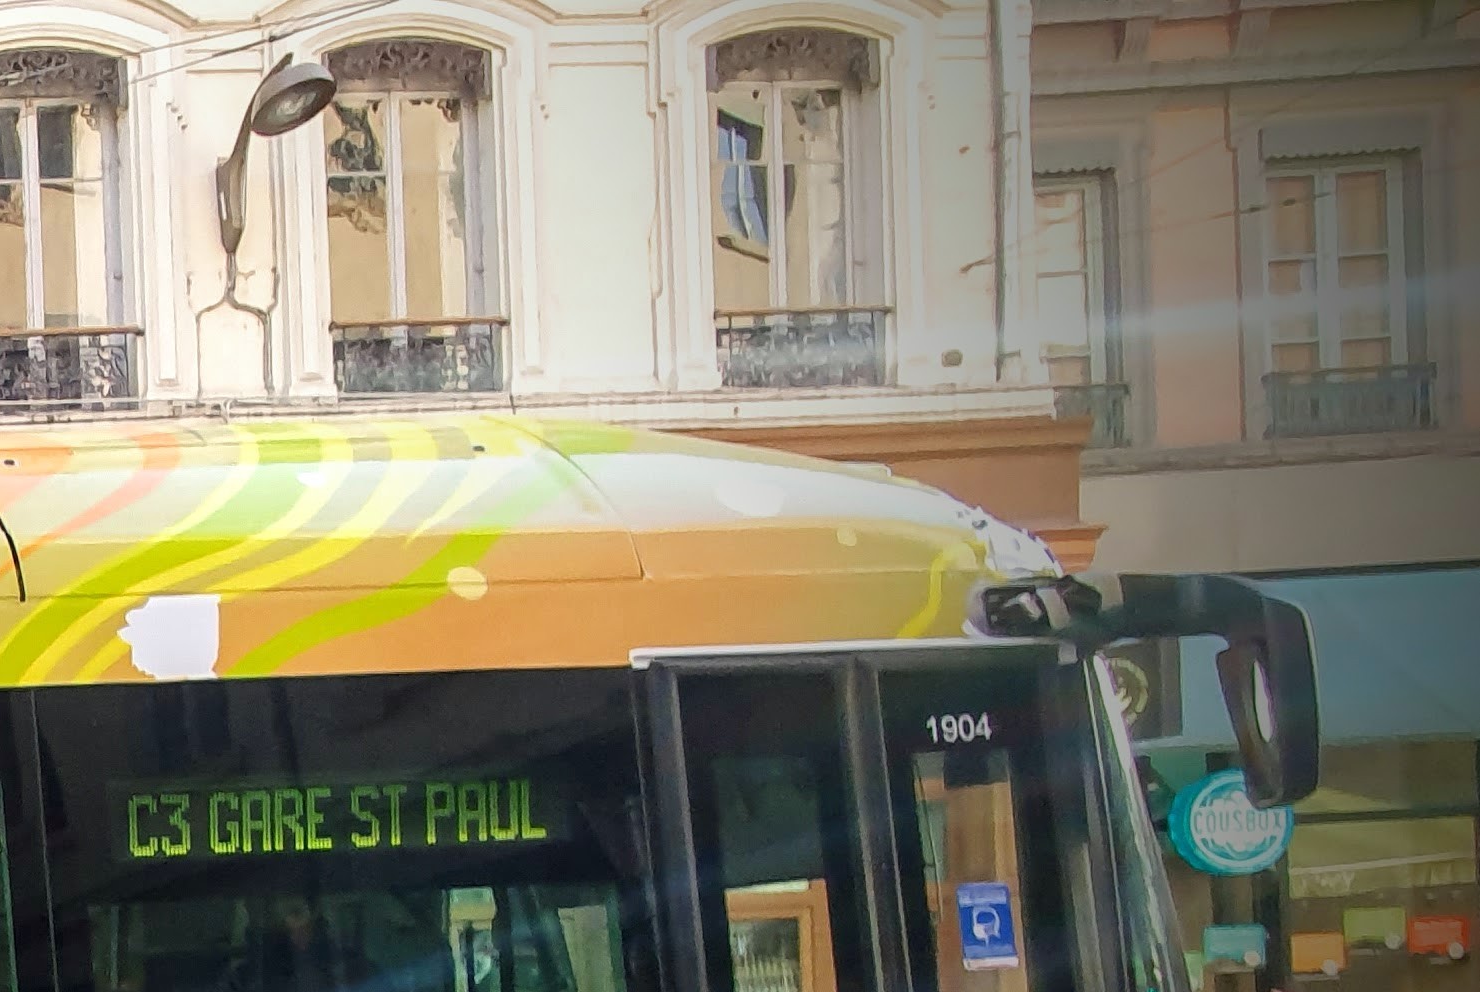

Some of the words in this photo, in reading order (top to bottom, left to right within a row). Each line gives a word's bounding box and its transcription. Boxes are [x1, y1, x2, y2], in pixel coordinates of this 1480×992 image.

[926, 711, 992, 744] 1904
[127, 794, 191, 857] C3
[209, 788, 333, 854] GARE
[350, 784, 407, 848] ST
[425, 778, 547, 846] PAUL
